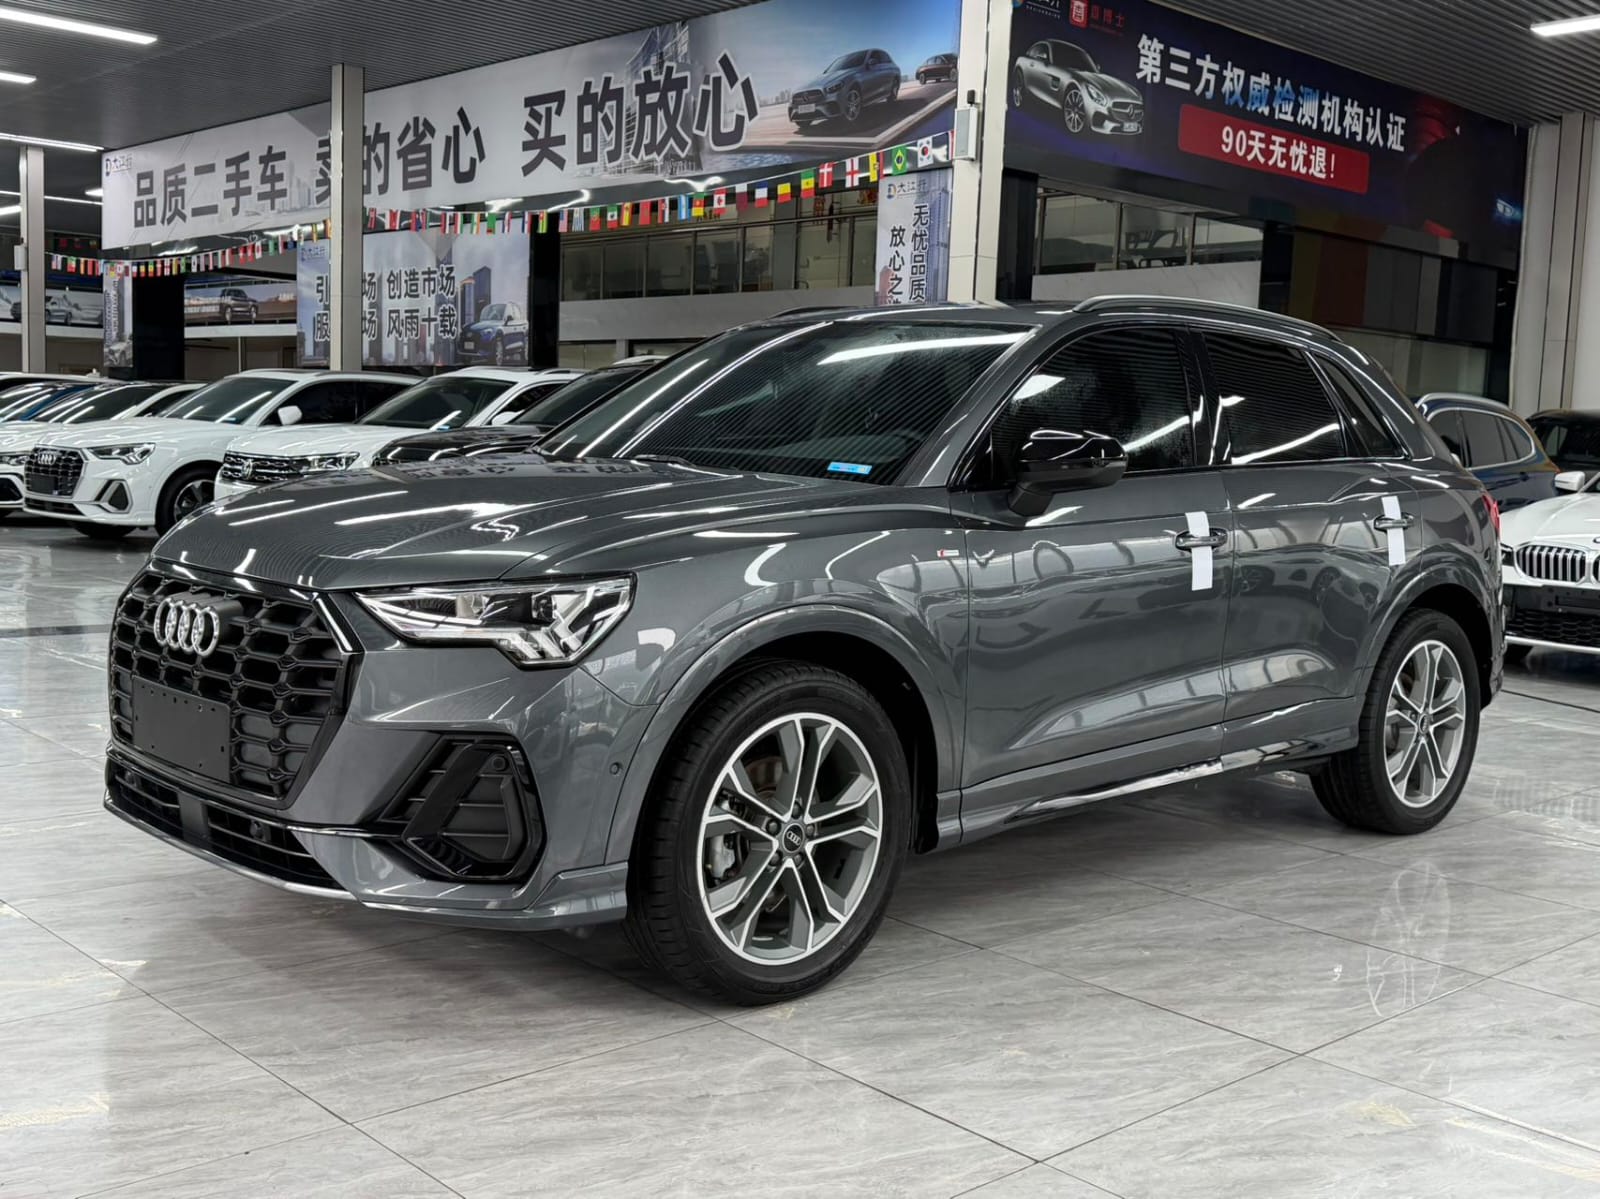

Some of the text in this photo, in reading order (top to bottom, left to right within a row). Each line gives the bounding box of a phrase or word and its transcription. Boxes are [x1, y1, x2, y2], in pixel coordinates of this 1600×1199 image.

[1136, 33, 1407, 152] 第三方权威检测机构认证
[134, 145, 288, 229] 品质二手车
[521, 51, 758, 177] 买的放心
[315, 266, 456, 304] 引场 创造市场
[887, 225, 906, 304] 放心之
[315, 305, 457, 341] 服场 风雨十载
